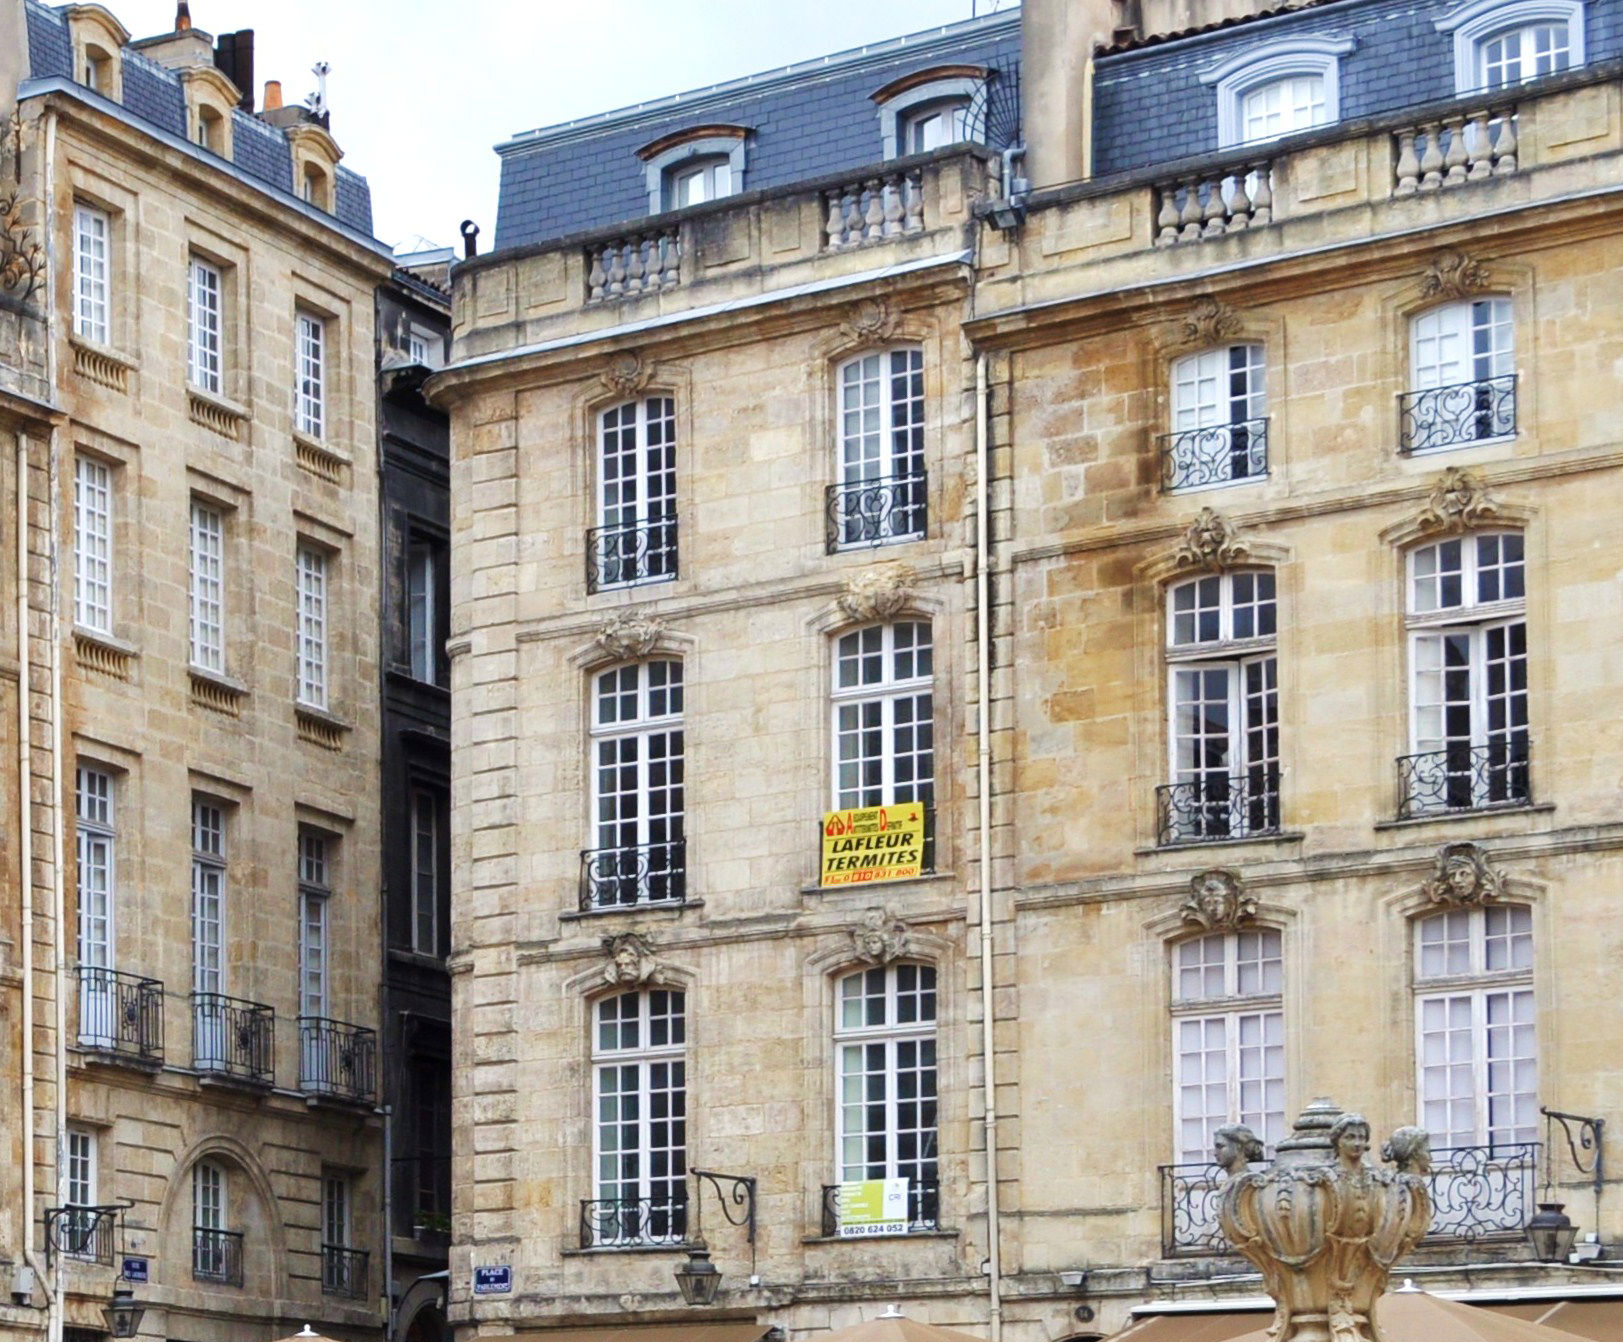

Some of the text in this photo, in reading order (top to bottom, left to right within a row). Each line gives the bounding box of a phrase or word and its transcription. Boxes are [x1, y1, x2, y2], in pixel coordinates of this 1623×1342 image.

[832, 832, 914, 854] LAFLEUR
[827, 849, 919, 872] TERMITES
[843, 1224, 903, 1235] 0820 624 052
[481, 1269, 504, 1277] PLACE
